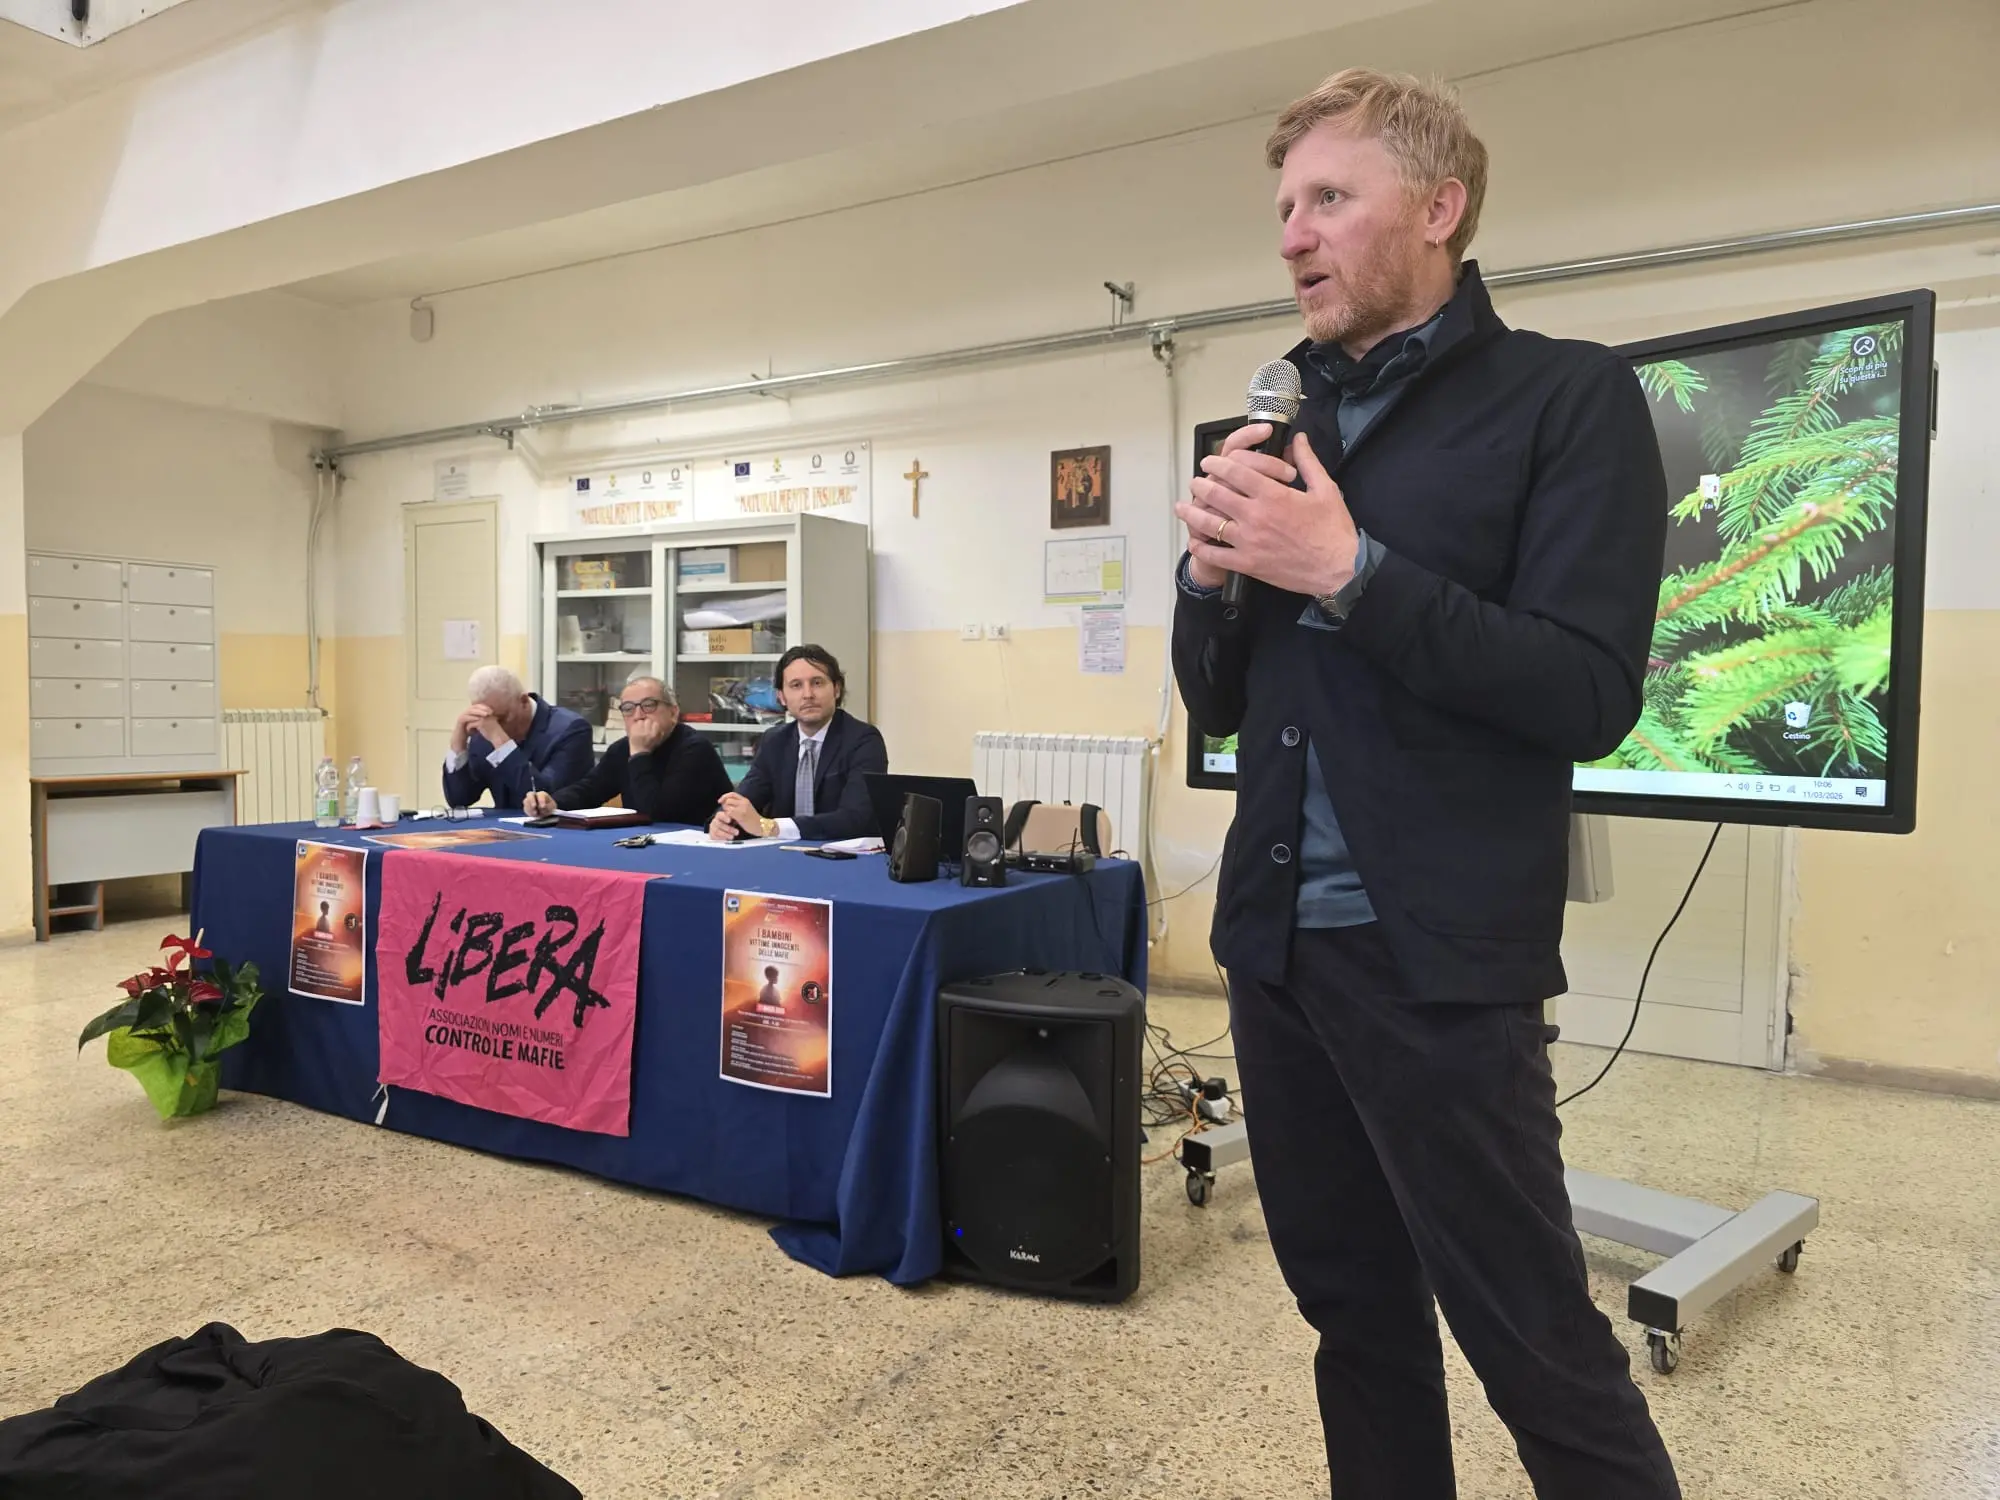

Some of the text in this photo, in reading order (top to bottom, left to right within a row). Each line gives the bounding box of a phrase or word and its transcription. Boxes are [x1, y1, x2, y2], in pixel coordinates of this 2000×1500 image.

[1782, 731, 1811, 740] Cestino
[1813, 780, 1832, 789] 10:06
[1803, 791, 1844, 800] 11/03/2026
[762, 928, 792, 941] BAMBINI
[491, 1022, 522, 1039] NOMI
[522, 1026, 528, 1039] E
[529, 1029, 563, 1047] NUMERI
[425, 1024, 491, 1056] CONTRO
[518, 1043, 565, 1070] MAFIE
